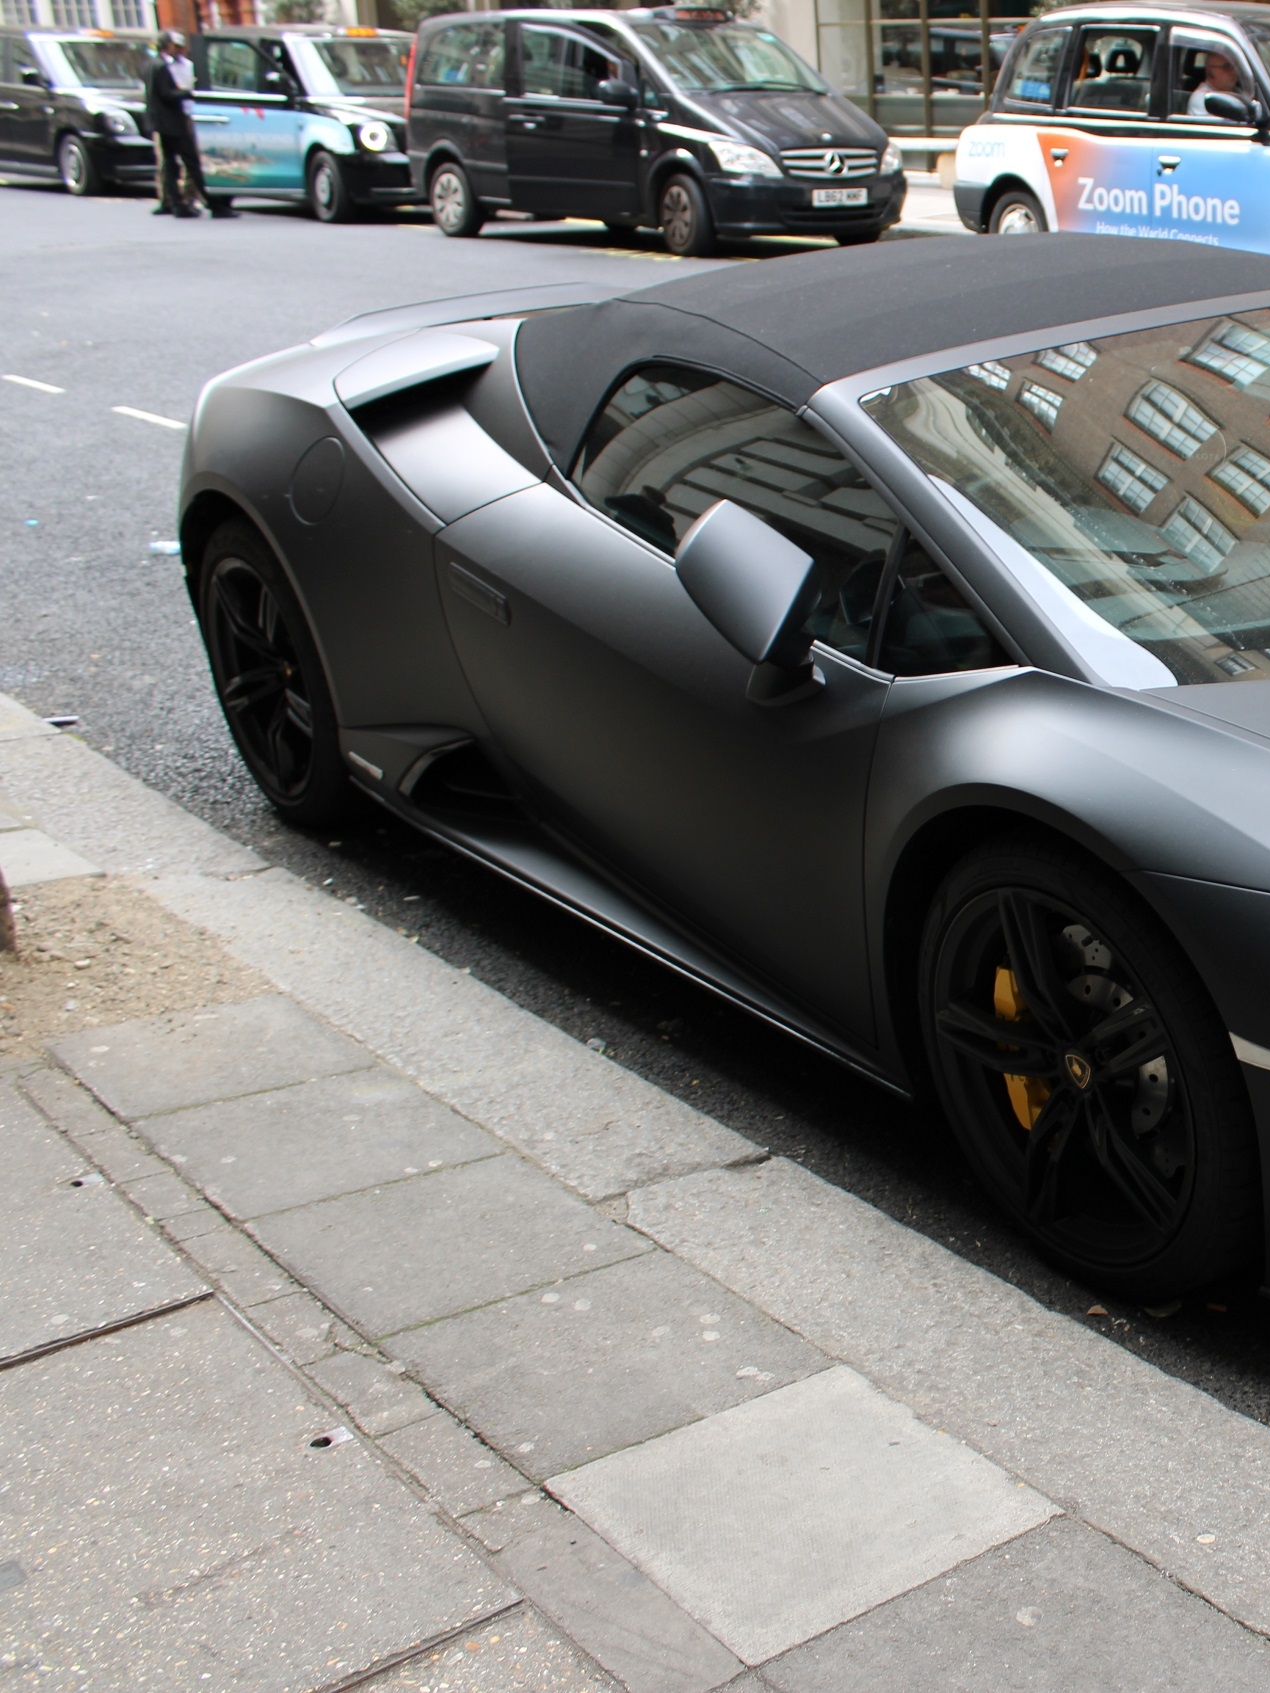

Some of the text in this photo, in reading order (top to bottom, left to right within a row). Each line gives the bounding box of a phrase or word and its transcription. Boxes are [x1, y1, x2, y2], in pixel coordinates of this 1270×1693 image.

[968, 141, 1006, 157] zoom
[1077, 176, 1241, 226] Zoom Phone
[1096, 221, 1119, 234] How
[1120, 223, 1137, 236] the
[1139, 225, 1169, 239] World
